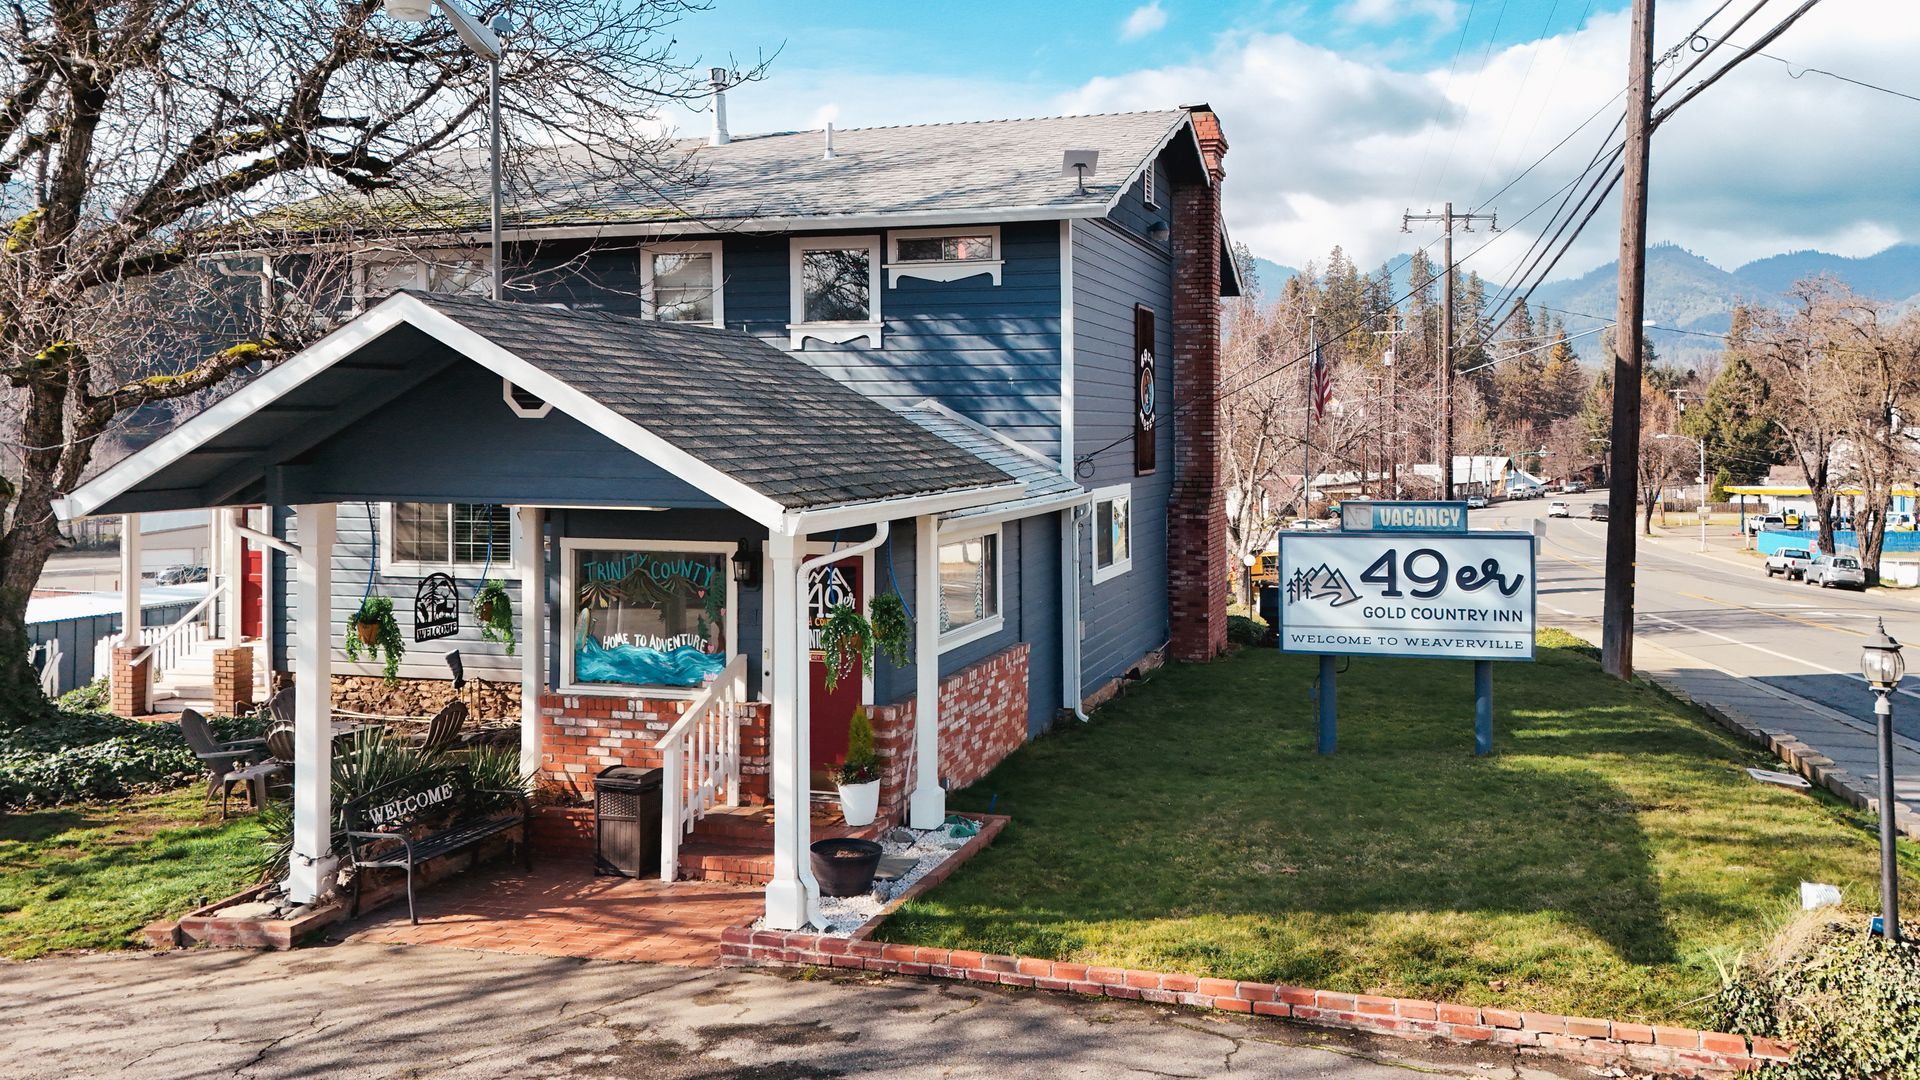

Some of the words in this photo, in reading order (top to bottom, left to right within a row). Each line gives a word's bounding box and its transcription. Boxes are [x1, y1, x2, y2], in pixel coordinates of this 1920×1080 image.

[1379, 508, 1461, 528] VACANCY
[584, 552, 649, 582] TRINITY
[651, 559, 716, 587] COUNTY
[1359, 548, 1525, 598] 49er
[1363, 606, 1405, 620] GOLD
[1411, 607, 1488, 622] COUNTRY
[1493, 609, 1523, 622] INN
[417, 622, 457, 639] WELCOME
[602, 632, 629, 650] HOME
[634, 634, 647, 646] TO
[649, 633, 708, 654] ADVENTURE
[1291, 634, 1371, 645] WELCOME
[1378, 637, 1398, 645] TO
[1404, 637, 1524, 650] WEAVERVILLE
[368, 782, 453, 825] WELCOME
